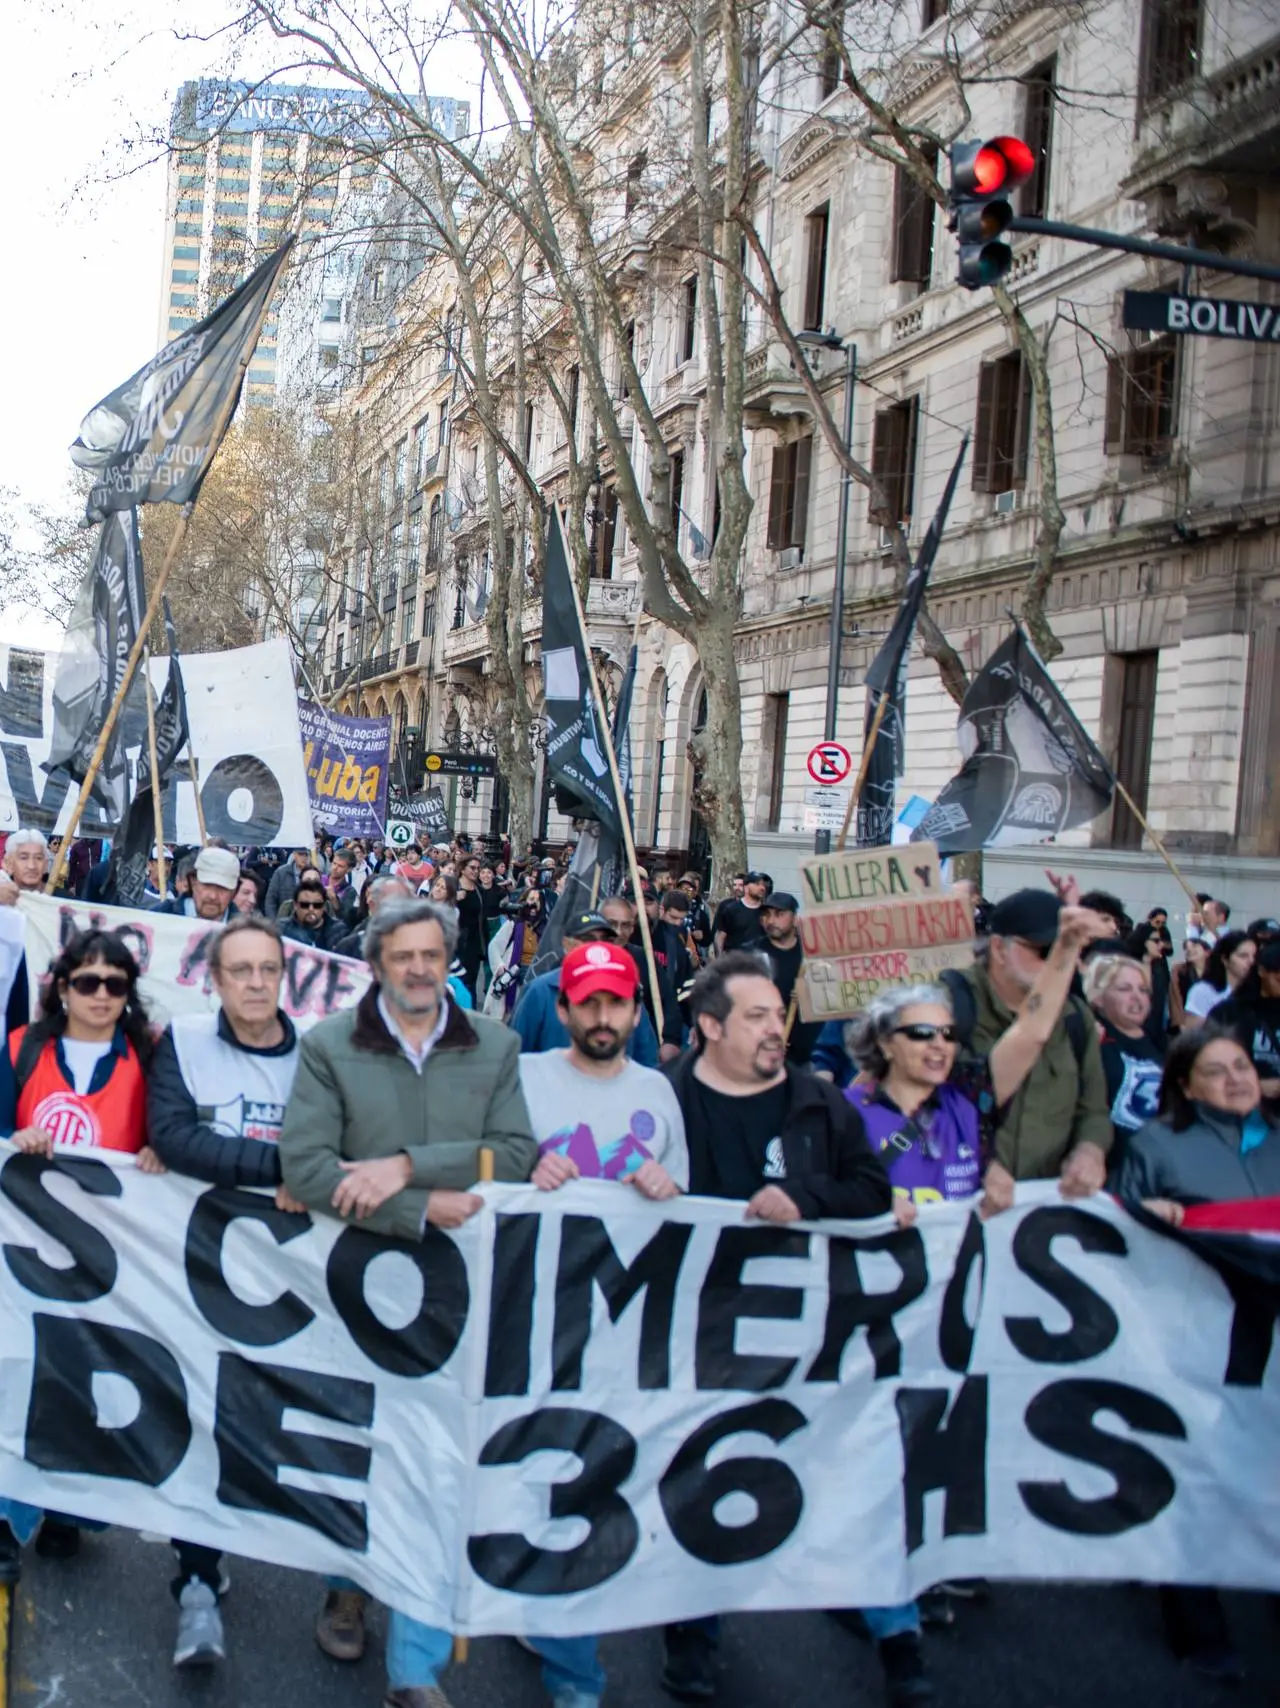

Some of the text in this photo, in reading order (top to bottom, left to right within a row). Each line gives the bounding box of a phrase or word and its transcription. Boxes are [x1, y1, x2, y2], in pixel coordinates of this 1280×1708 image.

[0, 741, 284, 847] VTO
[322, 802, 372, 817] HISTORICA
[802, 857, 931, 902] VILLERA Y
[798, 899, 971, 955] UNIVERSITARIA
[810, 965, 836, 983] EL
[835, 951, 910, 982] TERROR
[24, 1312, 376, 1554] DE
[467, 1398, 810, 1595] 36
[895, 1374, 1188, 1559] HS
